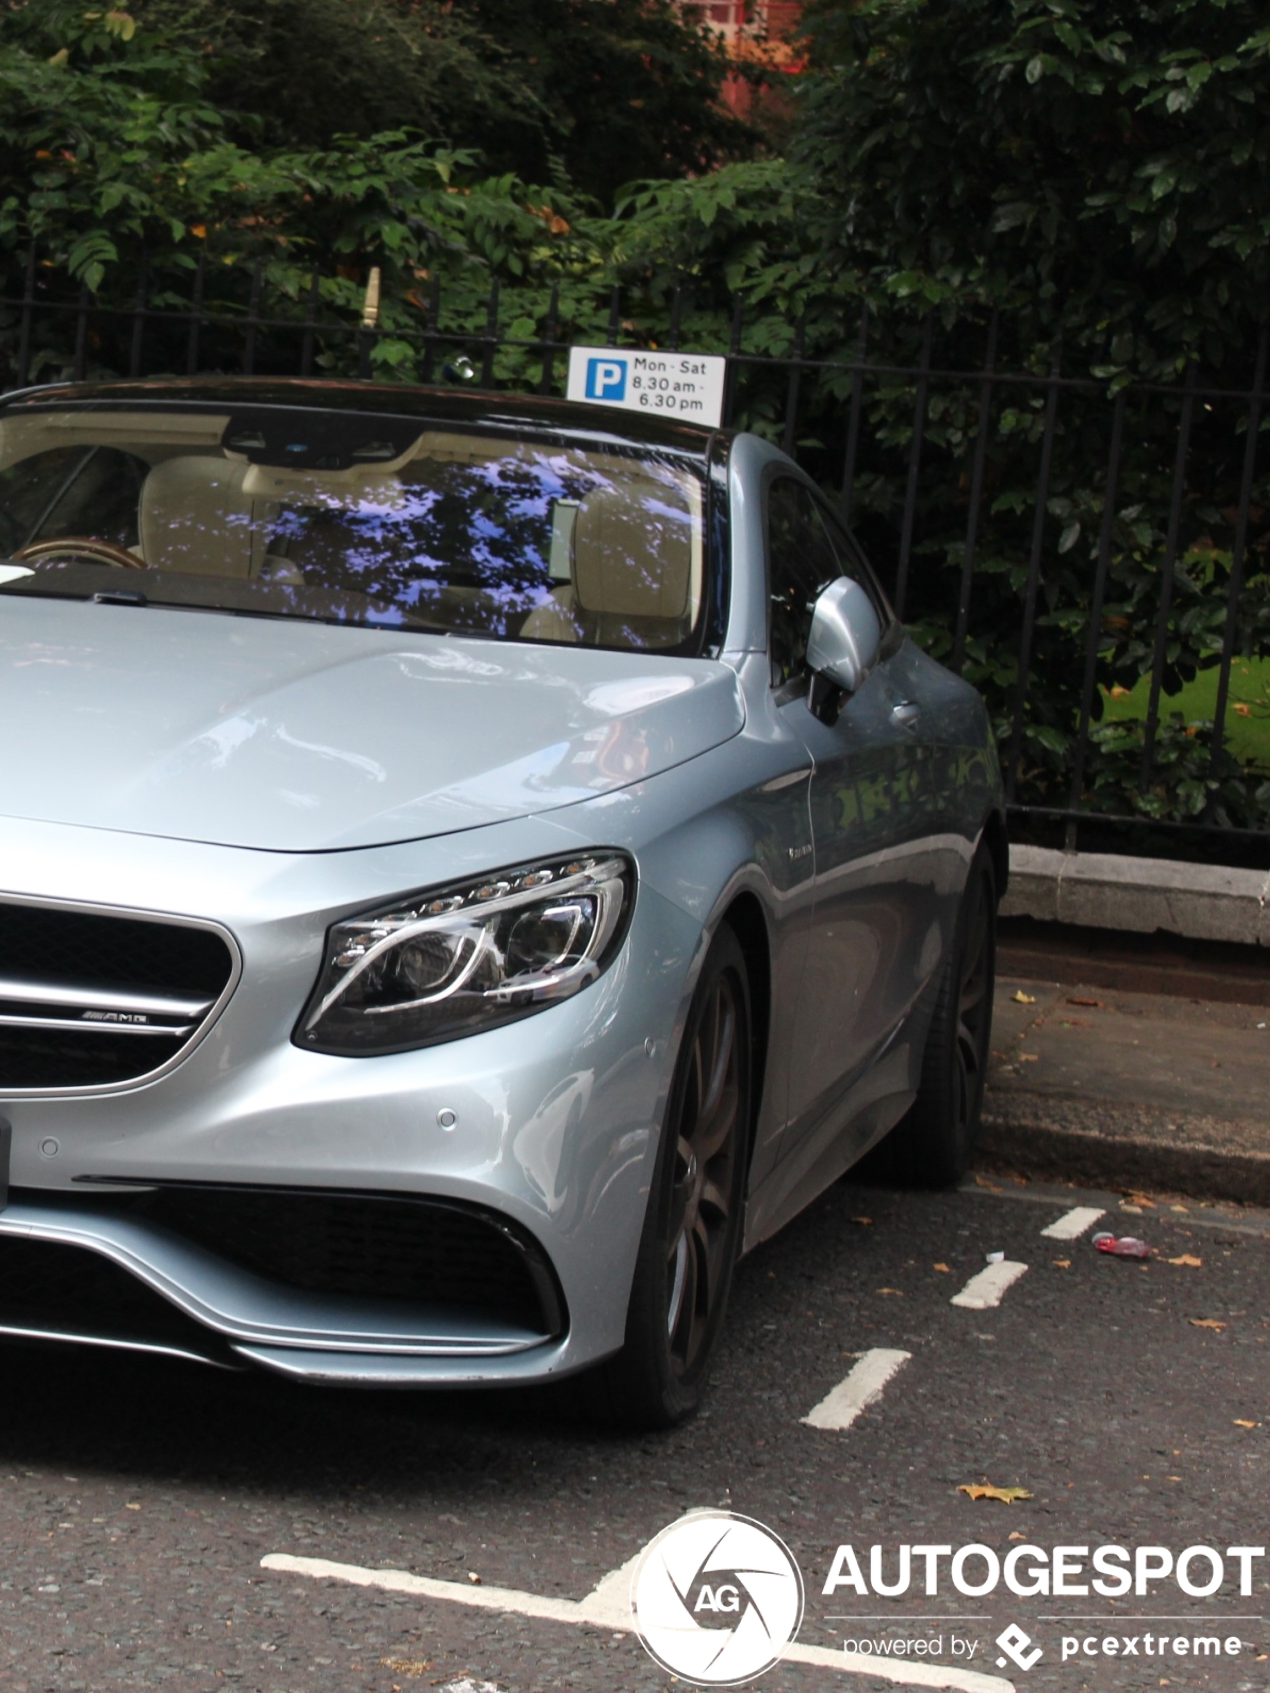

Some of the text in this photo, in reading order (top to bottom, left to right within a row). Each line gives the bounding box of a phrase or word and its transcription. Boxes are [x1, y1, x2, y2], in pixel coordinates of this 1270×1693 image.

[634, 358, 666, 372] Mon
[680, 361, 707, 375] Sat
[594, 362, 622, 397] P
[633, 377, 669, 390] 8.30
[673, 382, 696, 393] am
[639, 393, 703, 410] 6.30 pm
